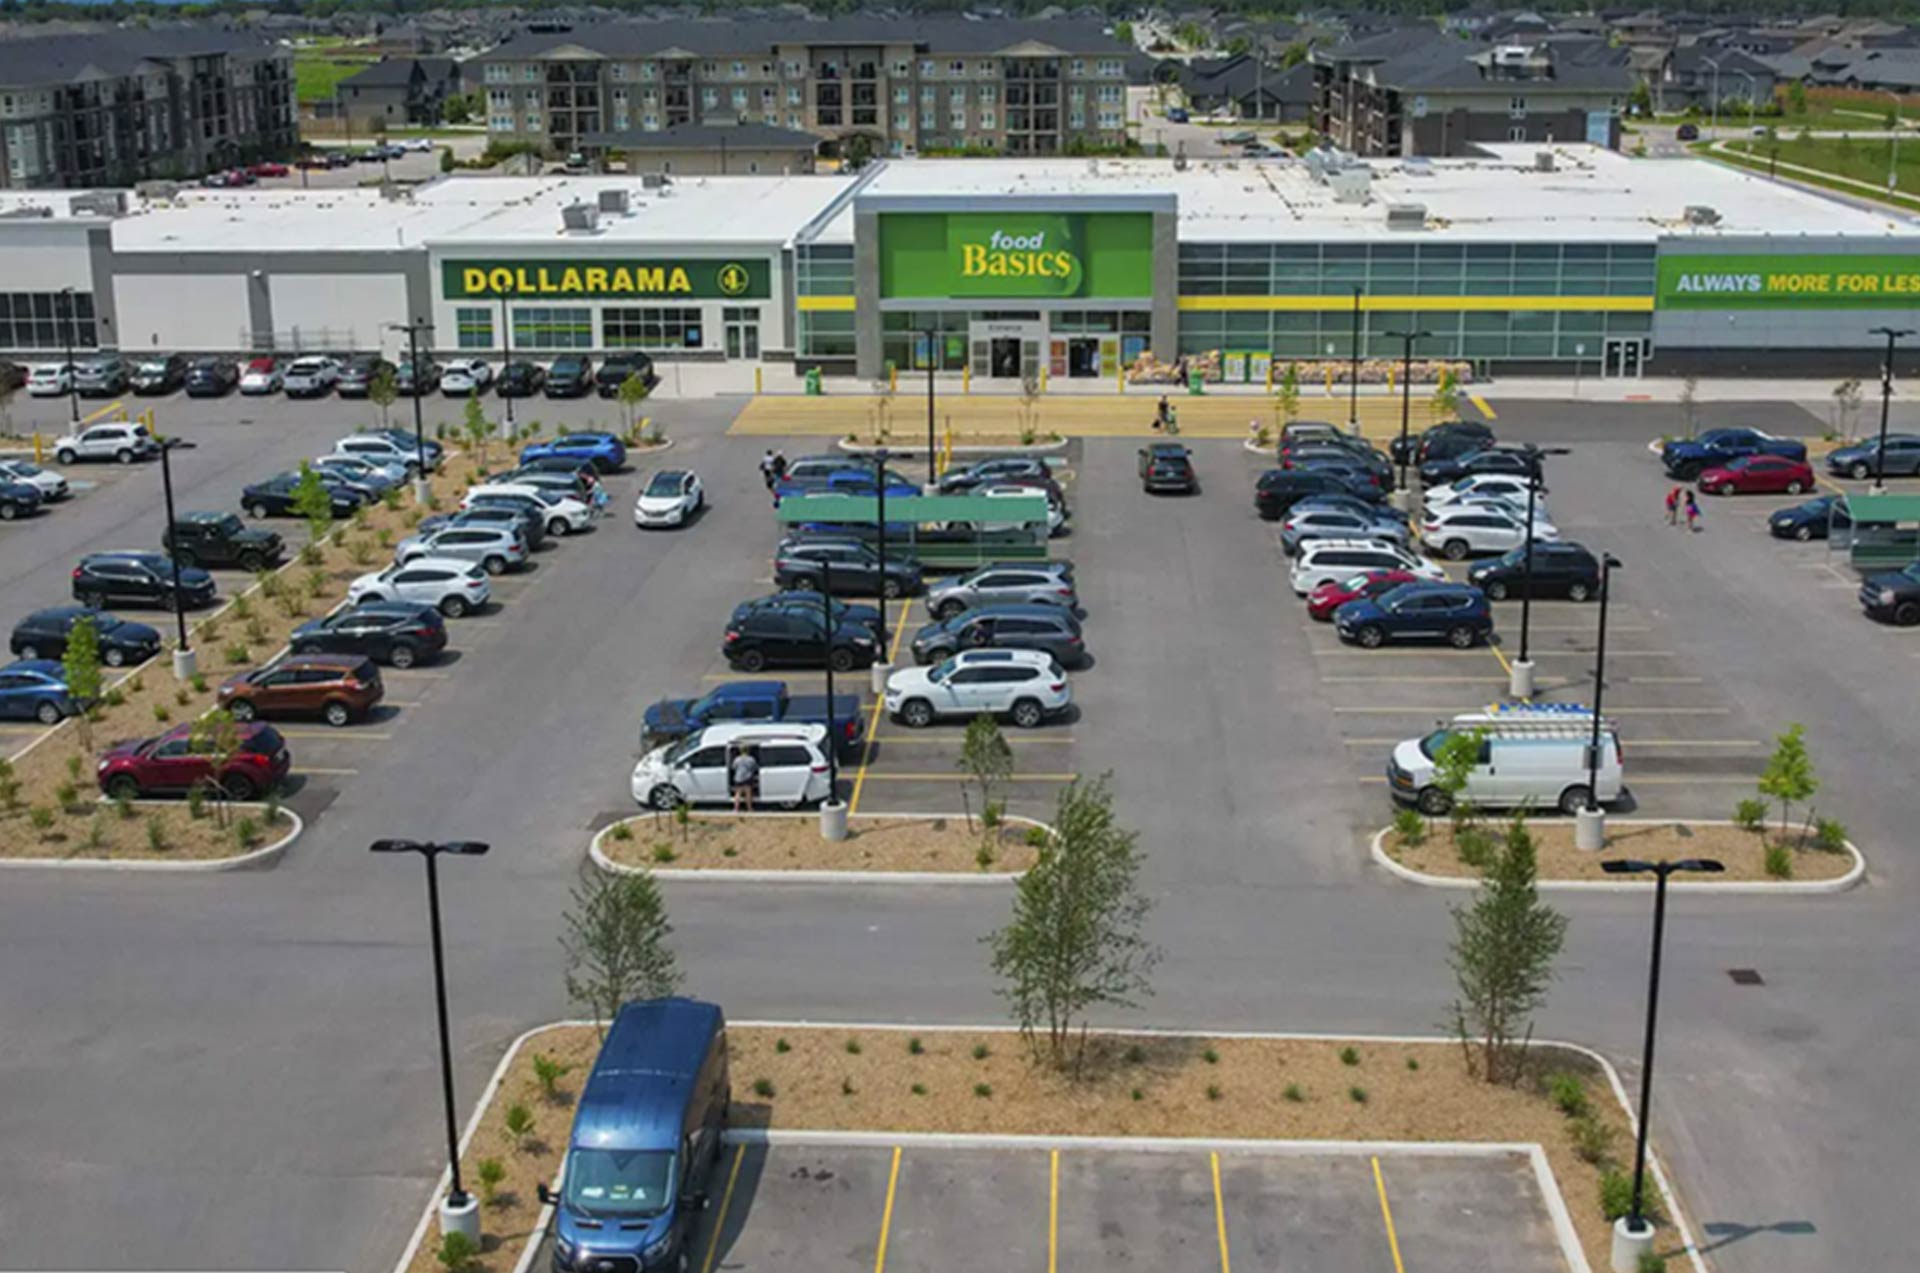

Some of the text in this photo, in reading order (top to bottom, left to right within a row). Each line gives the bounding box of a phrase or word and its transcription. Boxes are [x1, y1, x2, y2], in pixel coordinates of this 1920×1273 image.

[990, 231, 1045, 250] food
[962, 243, 1073, 278] Basics
[463, 267, 692, 293] DOLLARAMA
[1676, 274, 1761, 292] ALWAYS
[1767, 274, 1831, 292] MORE
[1836, 274, 1879, 292] FOR
